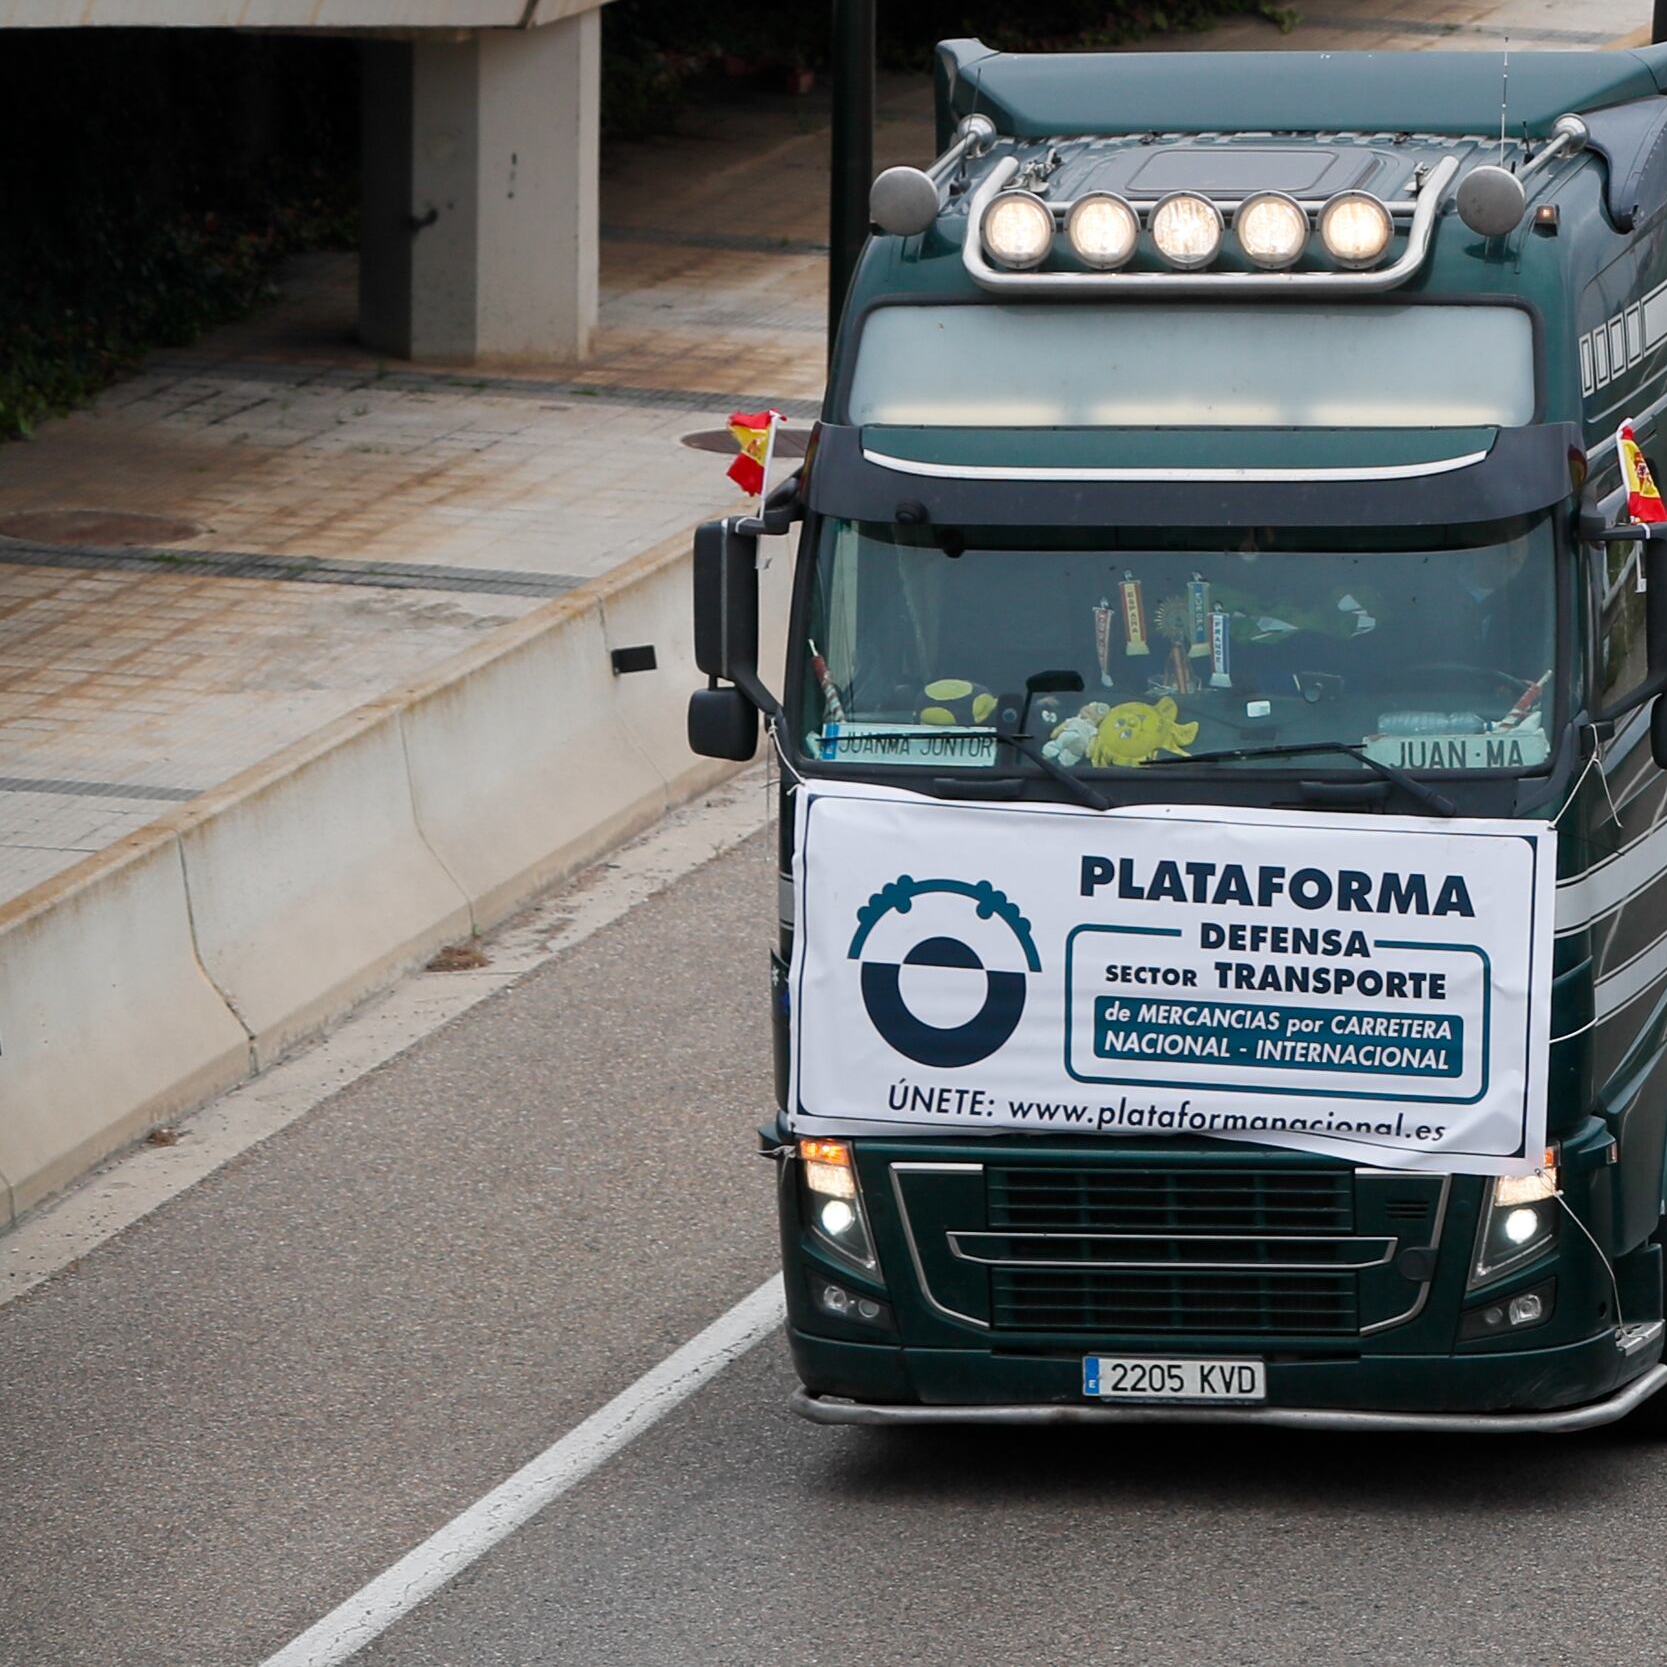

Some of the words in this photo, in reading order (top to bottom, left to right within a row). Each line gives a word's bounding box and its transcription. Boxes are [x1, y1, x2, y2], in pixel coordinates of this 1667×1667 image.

[1080, 855, 1476, 918] PLATAFORMA
[1200, 922, 1371, 958] DEFENSA
[1105, 964, 1198, 987] SECTOR
[1214, 961, 1446, 1000] TRANSPORTE
[1104, 1002, 1131, 1023] de
[1137, 1004, 1280, 1032] MERCANCIAS
[1286, 1018, 1326, 1035] por
[1331, 1016, 1453, 1040] CARRETERA
[1104, 1030, 1231, 1059] NACIONAL
[1255, 1039, 1450, 1070] INTERNACIONAL
[887, 1078, 996, 1117] ÚNETE:
[1008, 1096, 1446, 1142] www.plataformanacional.es
[1111, 1363, 1185, 1392] 2205
[1199, 1364, 1256, 1393] KVD
